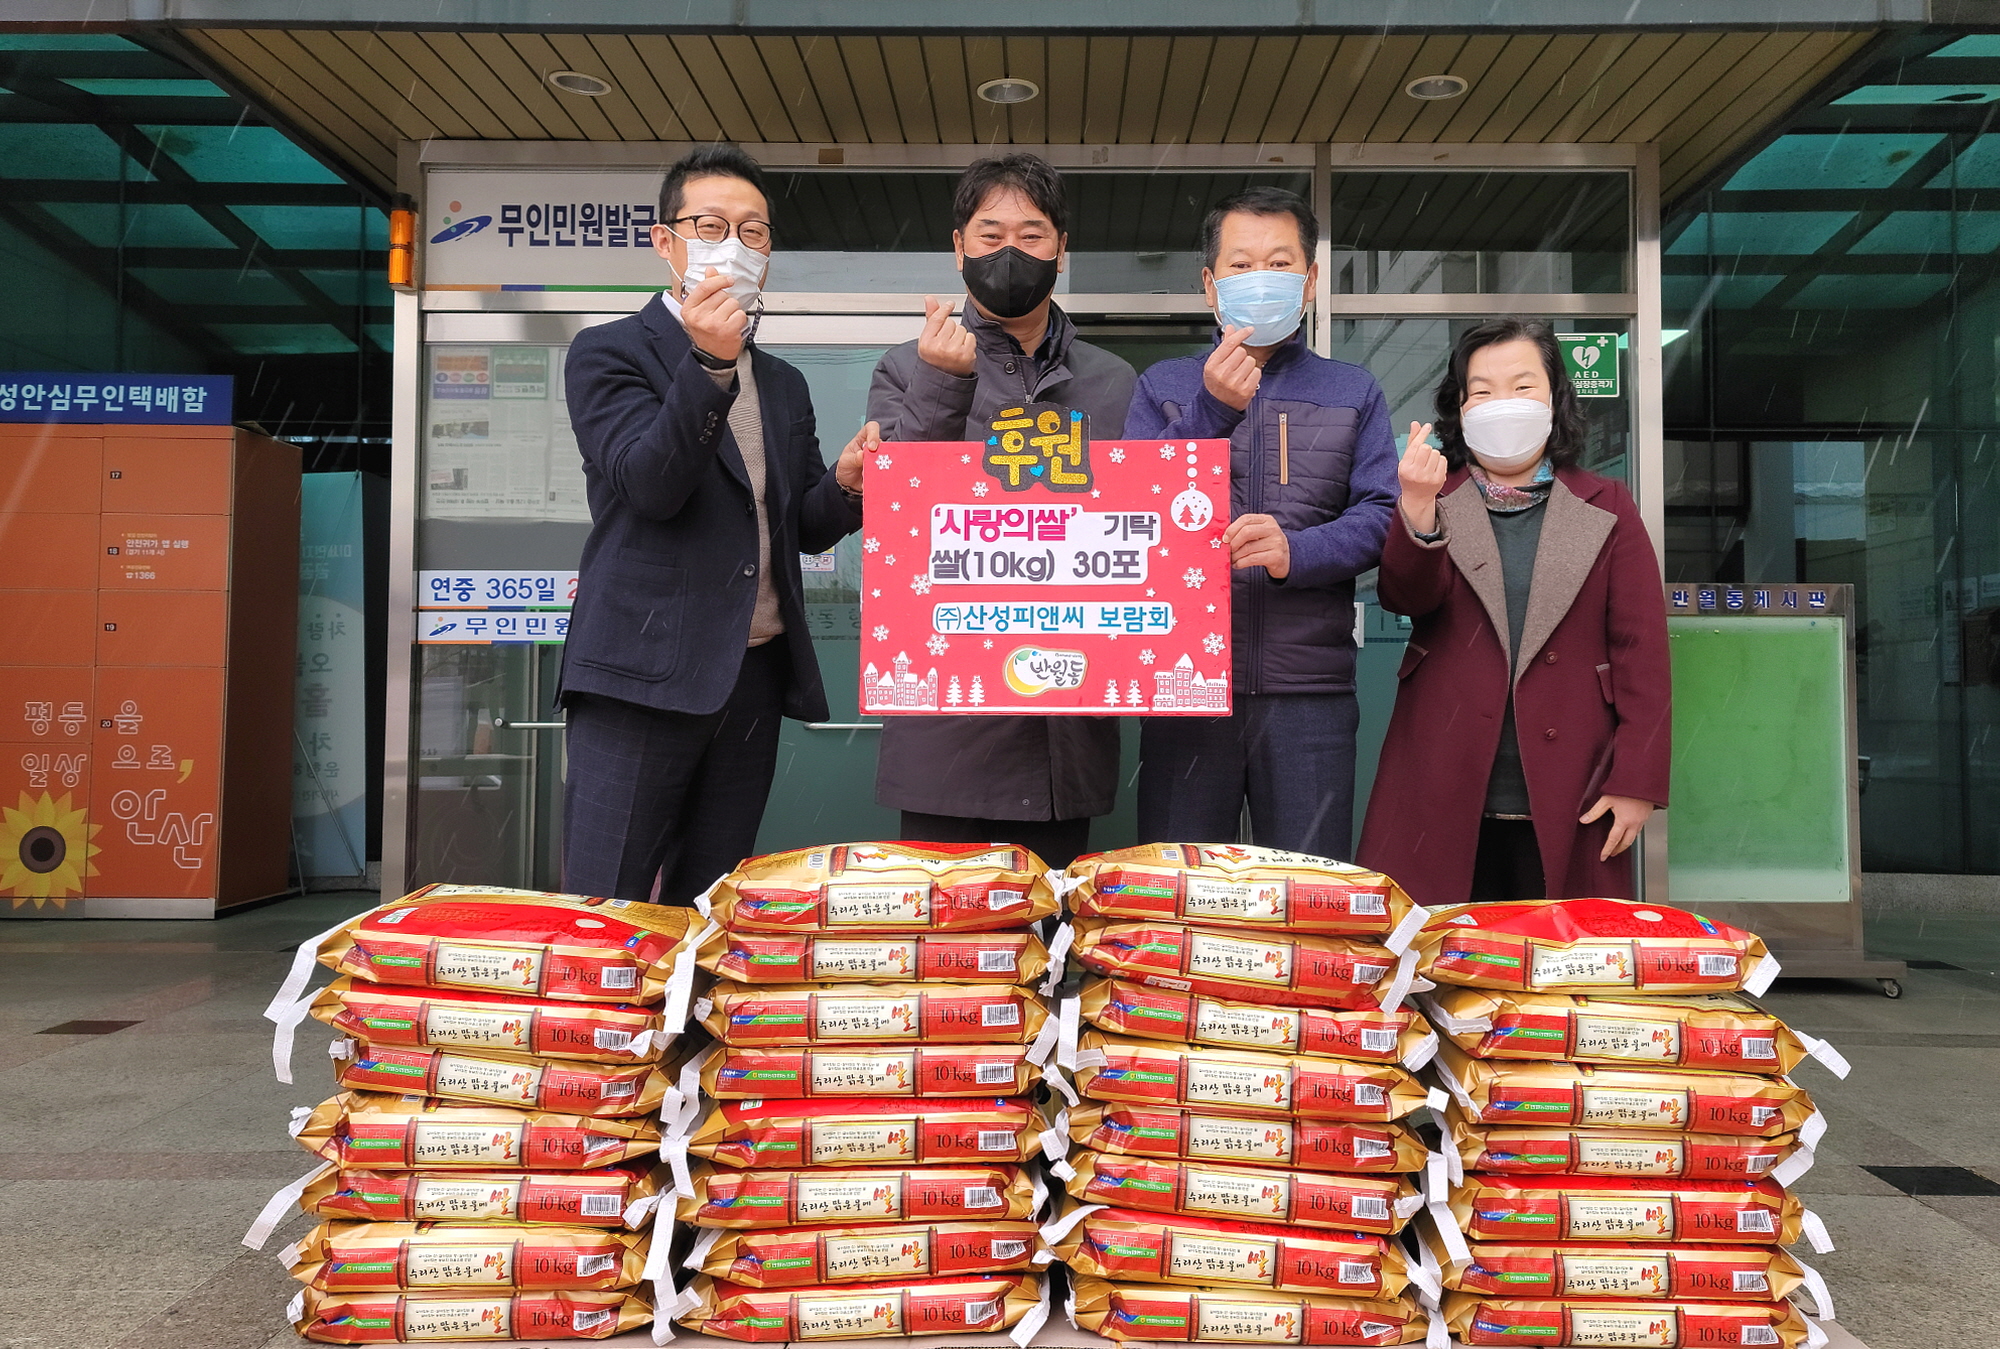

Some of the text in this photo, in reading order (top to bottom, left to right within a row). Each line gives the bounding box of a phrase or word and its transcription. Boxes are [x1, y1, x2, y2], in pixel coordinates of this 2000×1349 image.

[1573, 380, 1613, 388] 심장충격기
[0, 384, 207, 413] 성안심무인택배함
[989, 407, 1088, 486] 후원
[111, 471, 121, 479] 17
[1103, 514, 1157, 541] 기탁
[931, 550, 1141, 582] 쌀(10kg) 30포
[430, 577, 476, 602] 연중
[486, 577, 555, 602] 365일
[1098, 605, 1170, 631] 보람회
[1030, 658, 1083, 687] 반월동
[102, 720, 111, 728] 20
[111, 789, 213, 869] 안산
[1188, 897, 1216, 908] 수리산
[830, 905, 858, 916] 수리산
[816, 960, 844, 970] 수리산
[1193, 955, 1221, 967] 수리산
[438, 966, 466, 977] 수리산
[820, 1020, 847, 1030] 수리산
[1199, 1023, 1226, 1034] 수리산
[428, 1029, 457, 1039] 수리산
[1579, 1038, 1607, 1049] 수리산
[438, 1077, 466, 1089] 수리산
[814, 1076, 842, 1086] 수리산
[1190, 1083, 1218, 1094] 수리산
[1586, 1110, 1614, 1119] 수리산
[1192, 1138, 1220, 1149] 수리산
[417, 1145, 446, 1156] 수리산
[814, 1145, 843, 1154] 수리산
[1188, 1192, 1216, 1203] 수리산
[417, 1201, 445, 1211] 수리산
[800, 1202, 828, 1212] 수리산
[1572, 1220, 1601, 1230] 수리산
[830, 1259, 858, 1270] 수리산
[1173, 1258, 1202, 1269] 수리산
[410, 1268, 438, 1278] 수리산
[1567, 1280, 1596, 1290] 수리산
[407, 1323, 437, 1333] 수리산
[802, 1320, 830, 1330] 수리산
[1201, 1324, 1230, 1334] 수리산
[1574, 1332, 1604, 1342] 수리산
